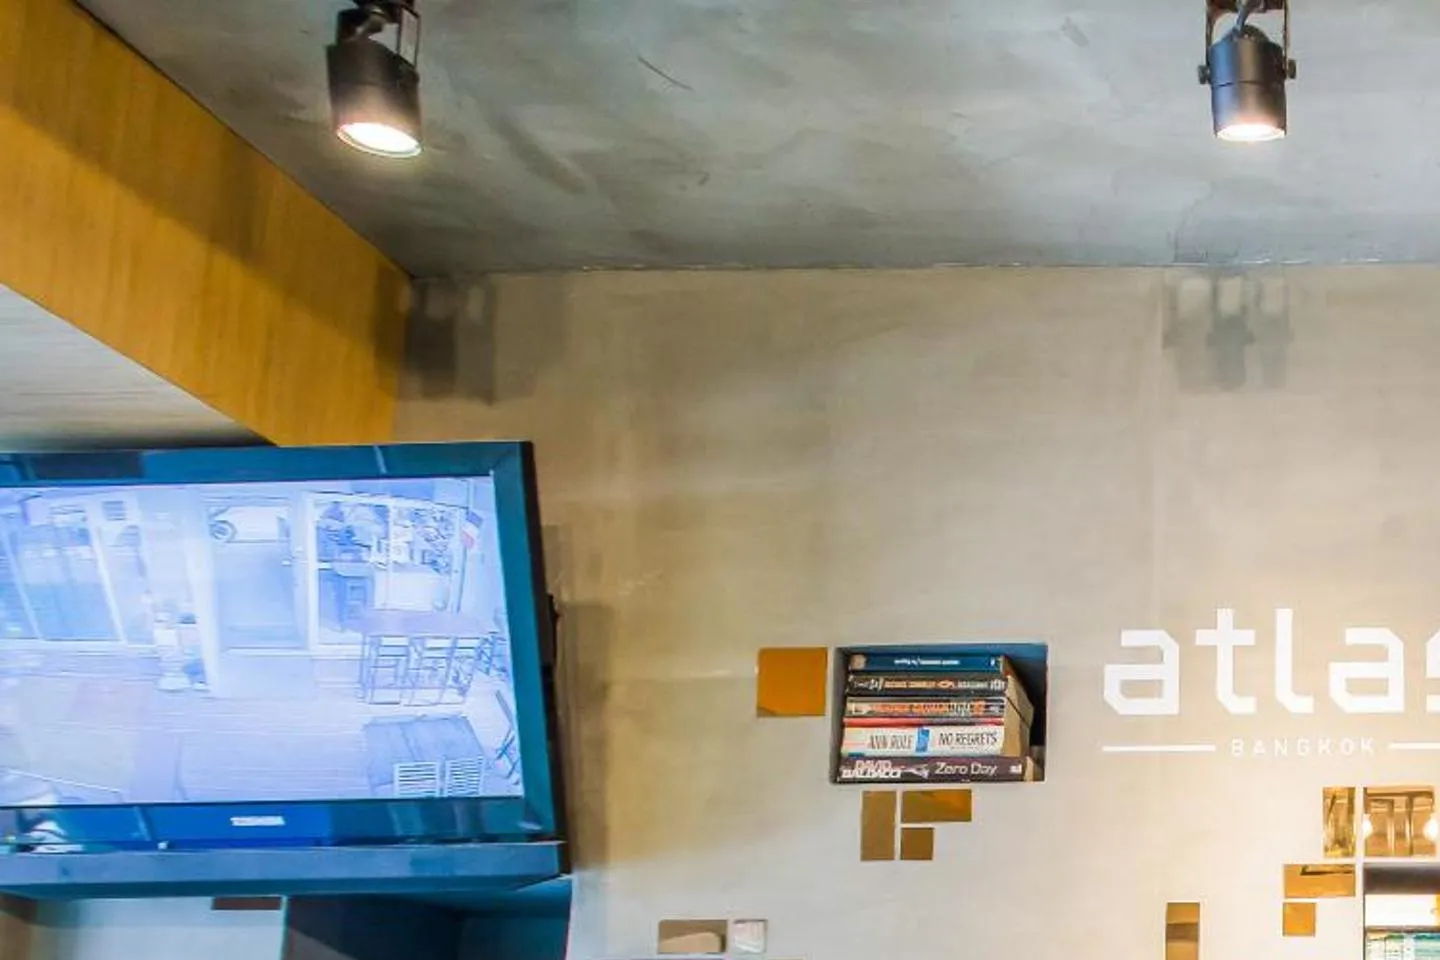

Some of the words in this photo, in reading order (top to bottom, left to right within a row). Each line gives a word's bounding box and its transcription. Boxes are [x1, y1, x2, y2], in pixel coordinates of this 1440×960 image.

[1231, 738, 1376, 758] BANGKOK
[935, 761, 968, 775] Zero
[971, 761, 998, 775] Day
